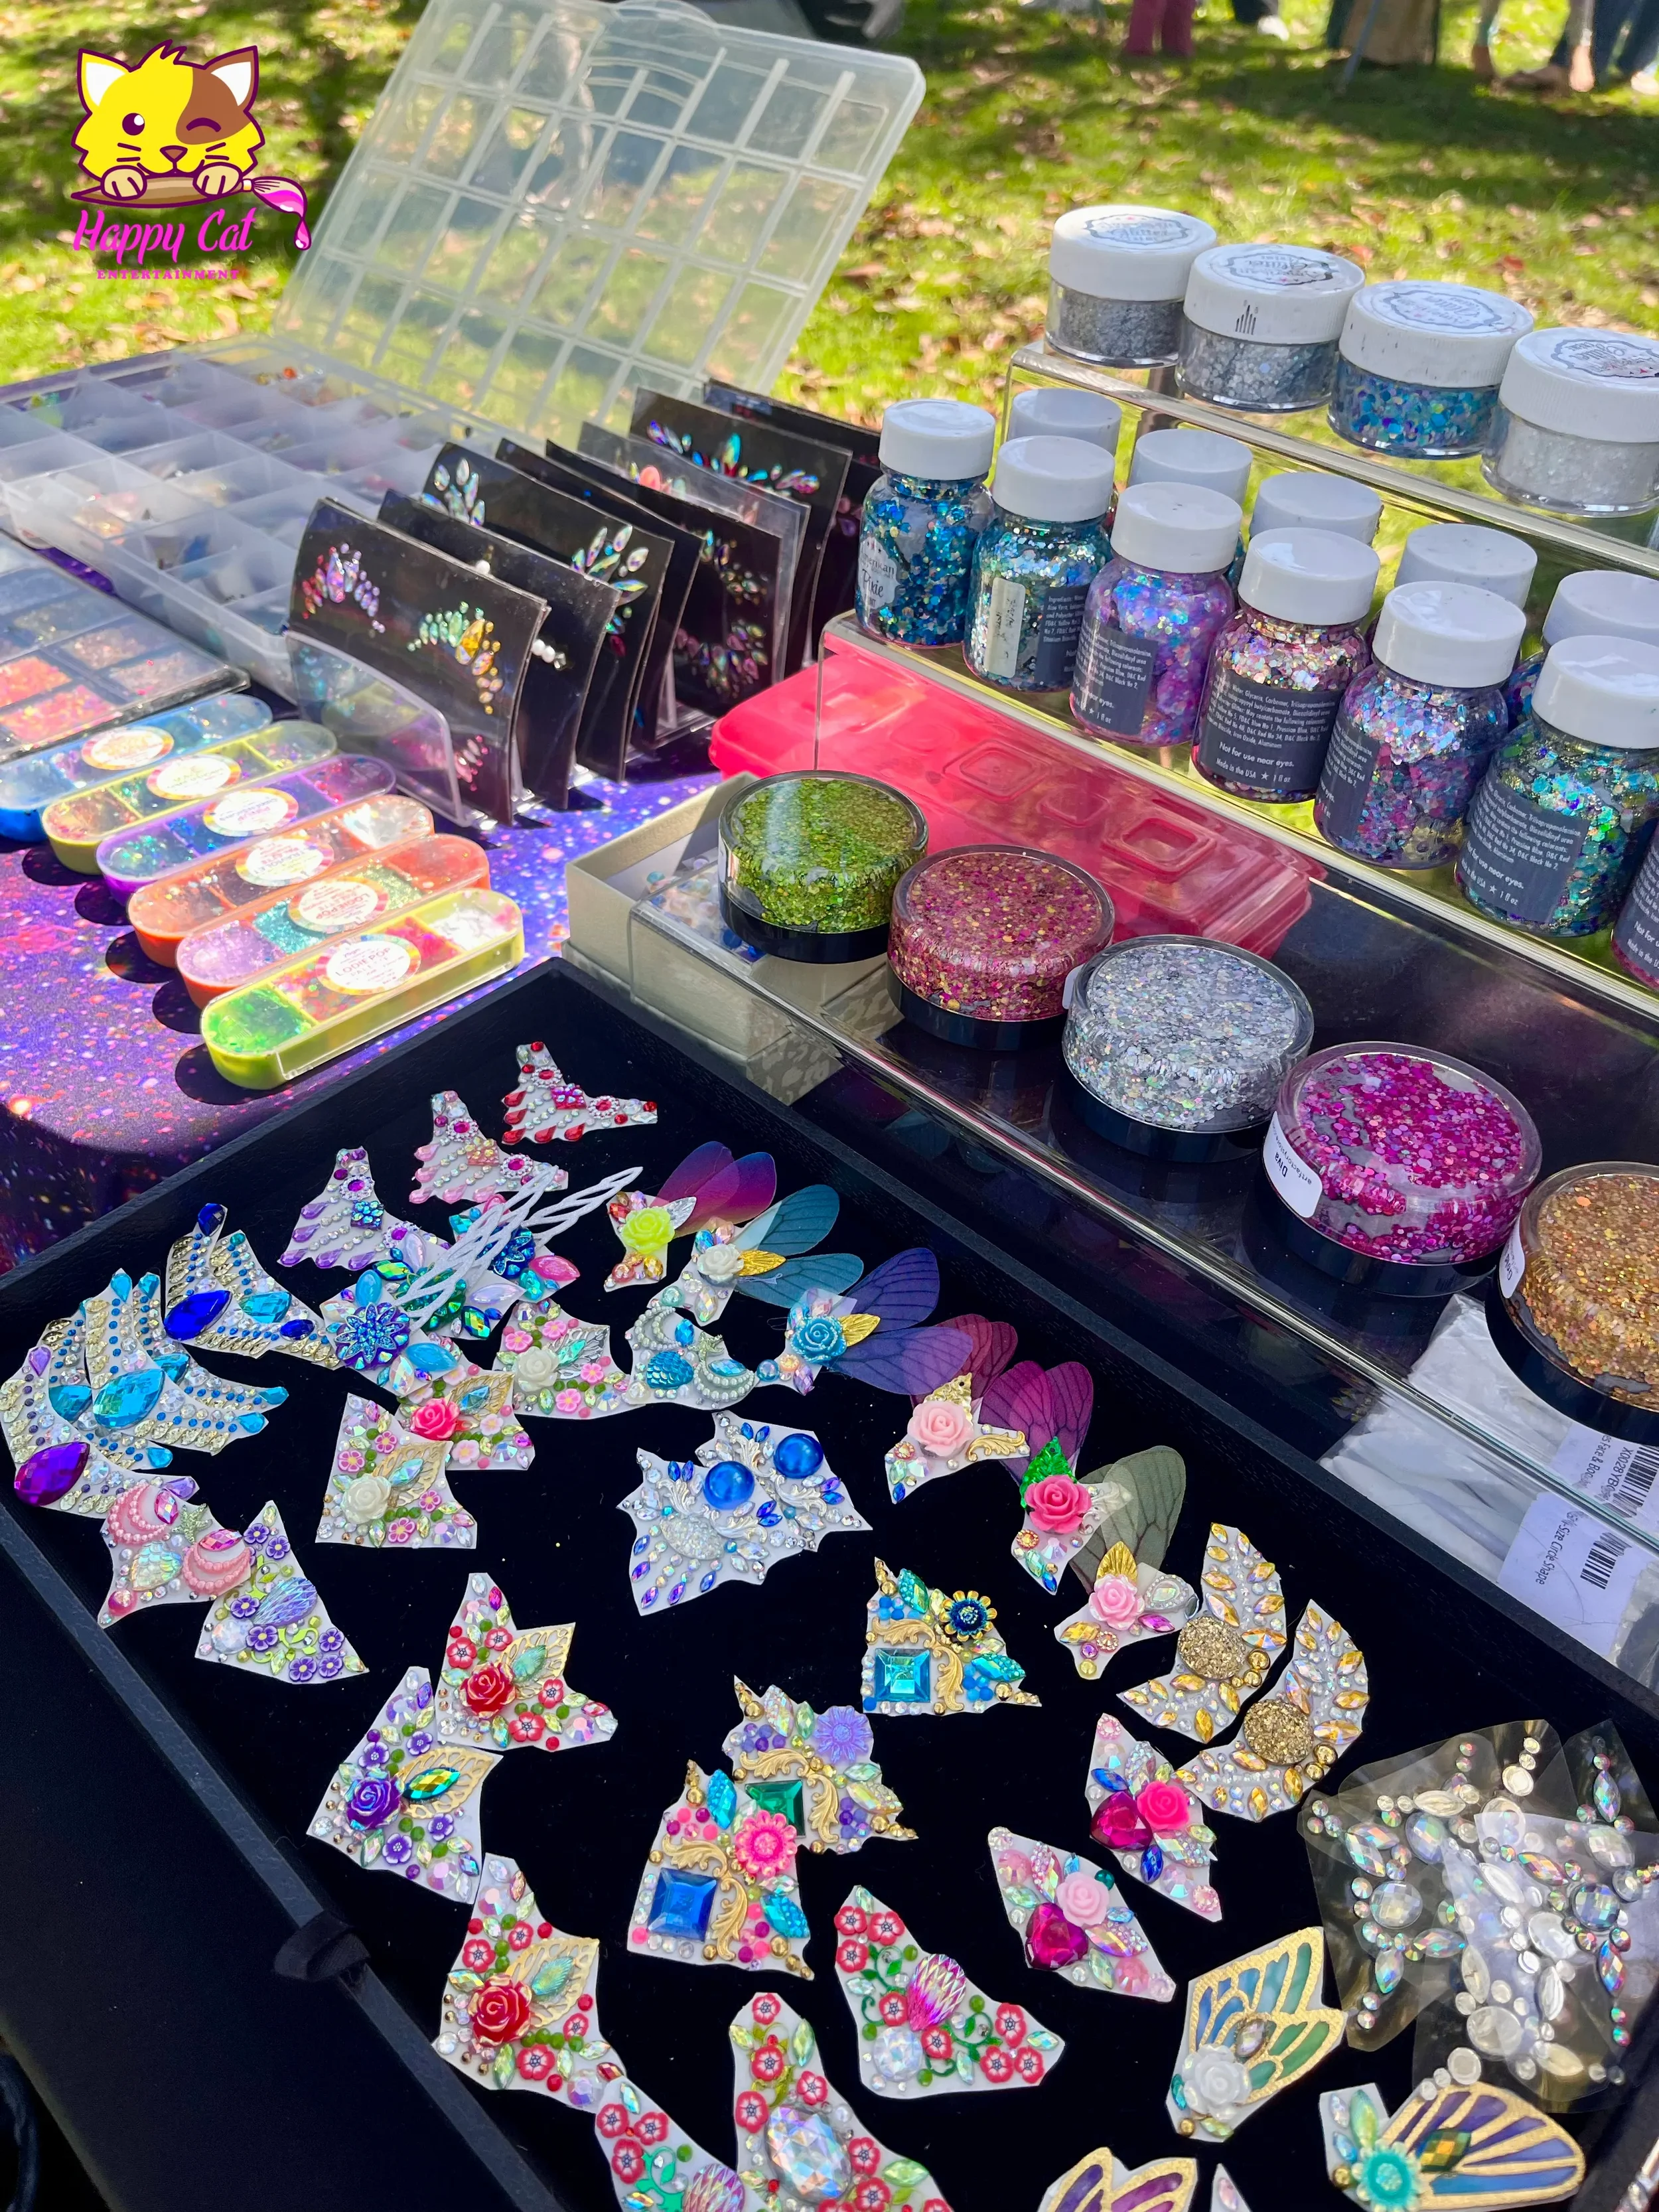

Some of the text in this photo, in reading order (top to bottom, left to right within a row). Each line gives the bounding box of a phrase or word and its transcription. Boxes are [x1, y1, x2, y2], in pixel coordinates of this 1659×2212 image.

[862, 569, 884, 598] Pixie
[1099, 698, 1115, 708] eyes.
[1218, 741, 1295, 769] Not for use near eyes.
[1216, 757, 1229, 770] Made
[1235, 767, 1244, 776] the
[1245, 769, 1257, 779] USA
[1278, 774, 1283, 782] fl
[1517, 849, 1530, 861] D&C
[1529, 855, 1544, 865] Black
[1559, 854, 1571, 863] Red
[1477, 876, 1486, 888] USA
[1479, 858, 1488, 870] use
[1488, 865, 1505, 879] near
[1504, 876, 1525, 890] eyes.
[1510, 898, 1519, 907] oz
[1634, 921, 1656, 943] Not for
[368, 947, 392, 962] POP
[1627, 938, 1639, 954] Made
[1637, 948, 1644, 958] in
[1644, 952, 1653, 964] the
[1274, 1151, 1288, 1178] Diva
[1594, 1442, 1611, 1457] Face
[1591, 1455, 1604, 1465] &
[1534, 1540, 1563, 1585] Circle Shape
